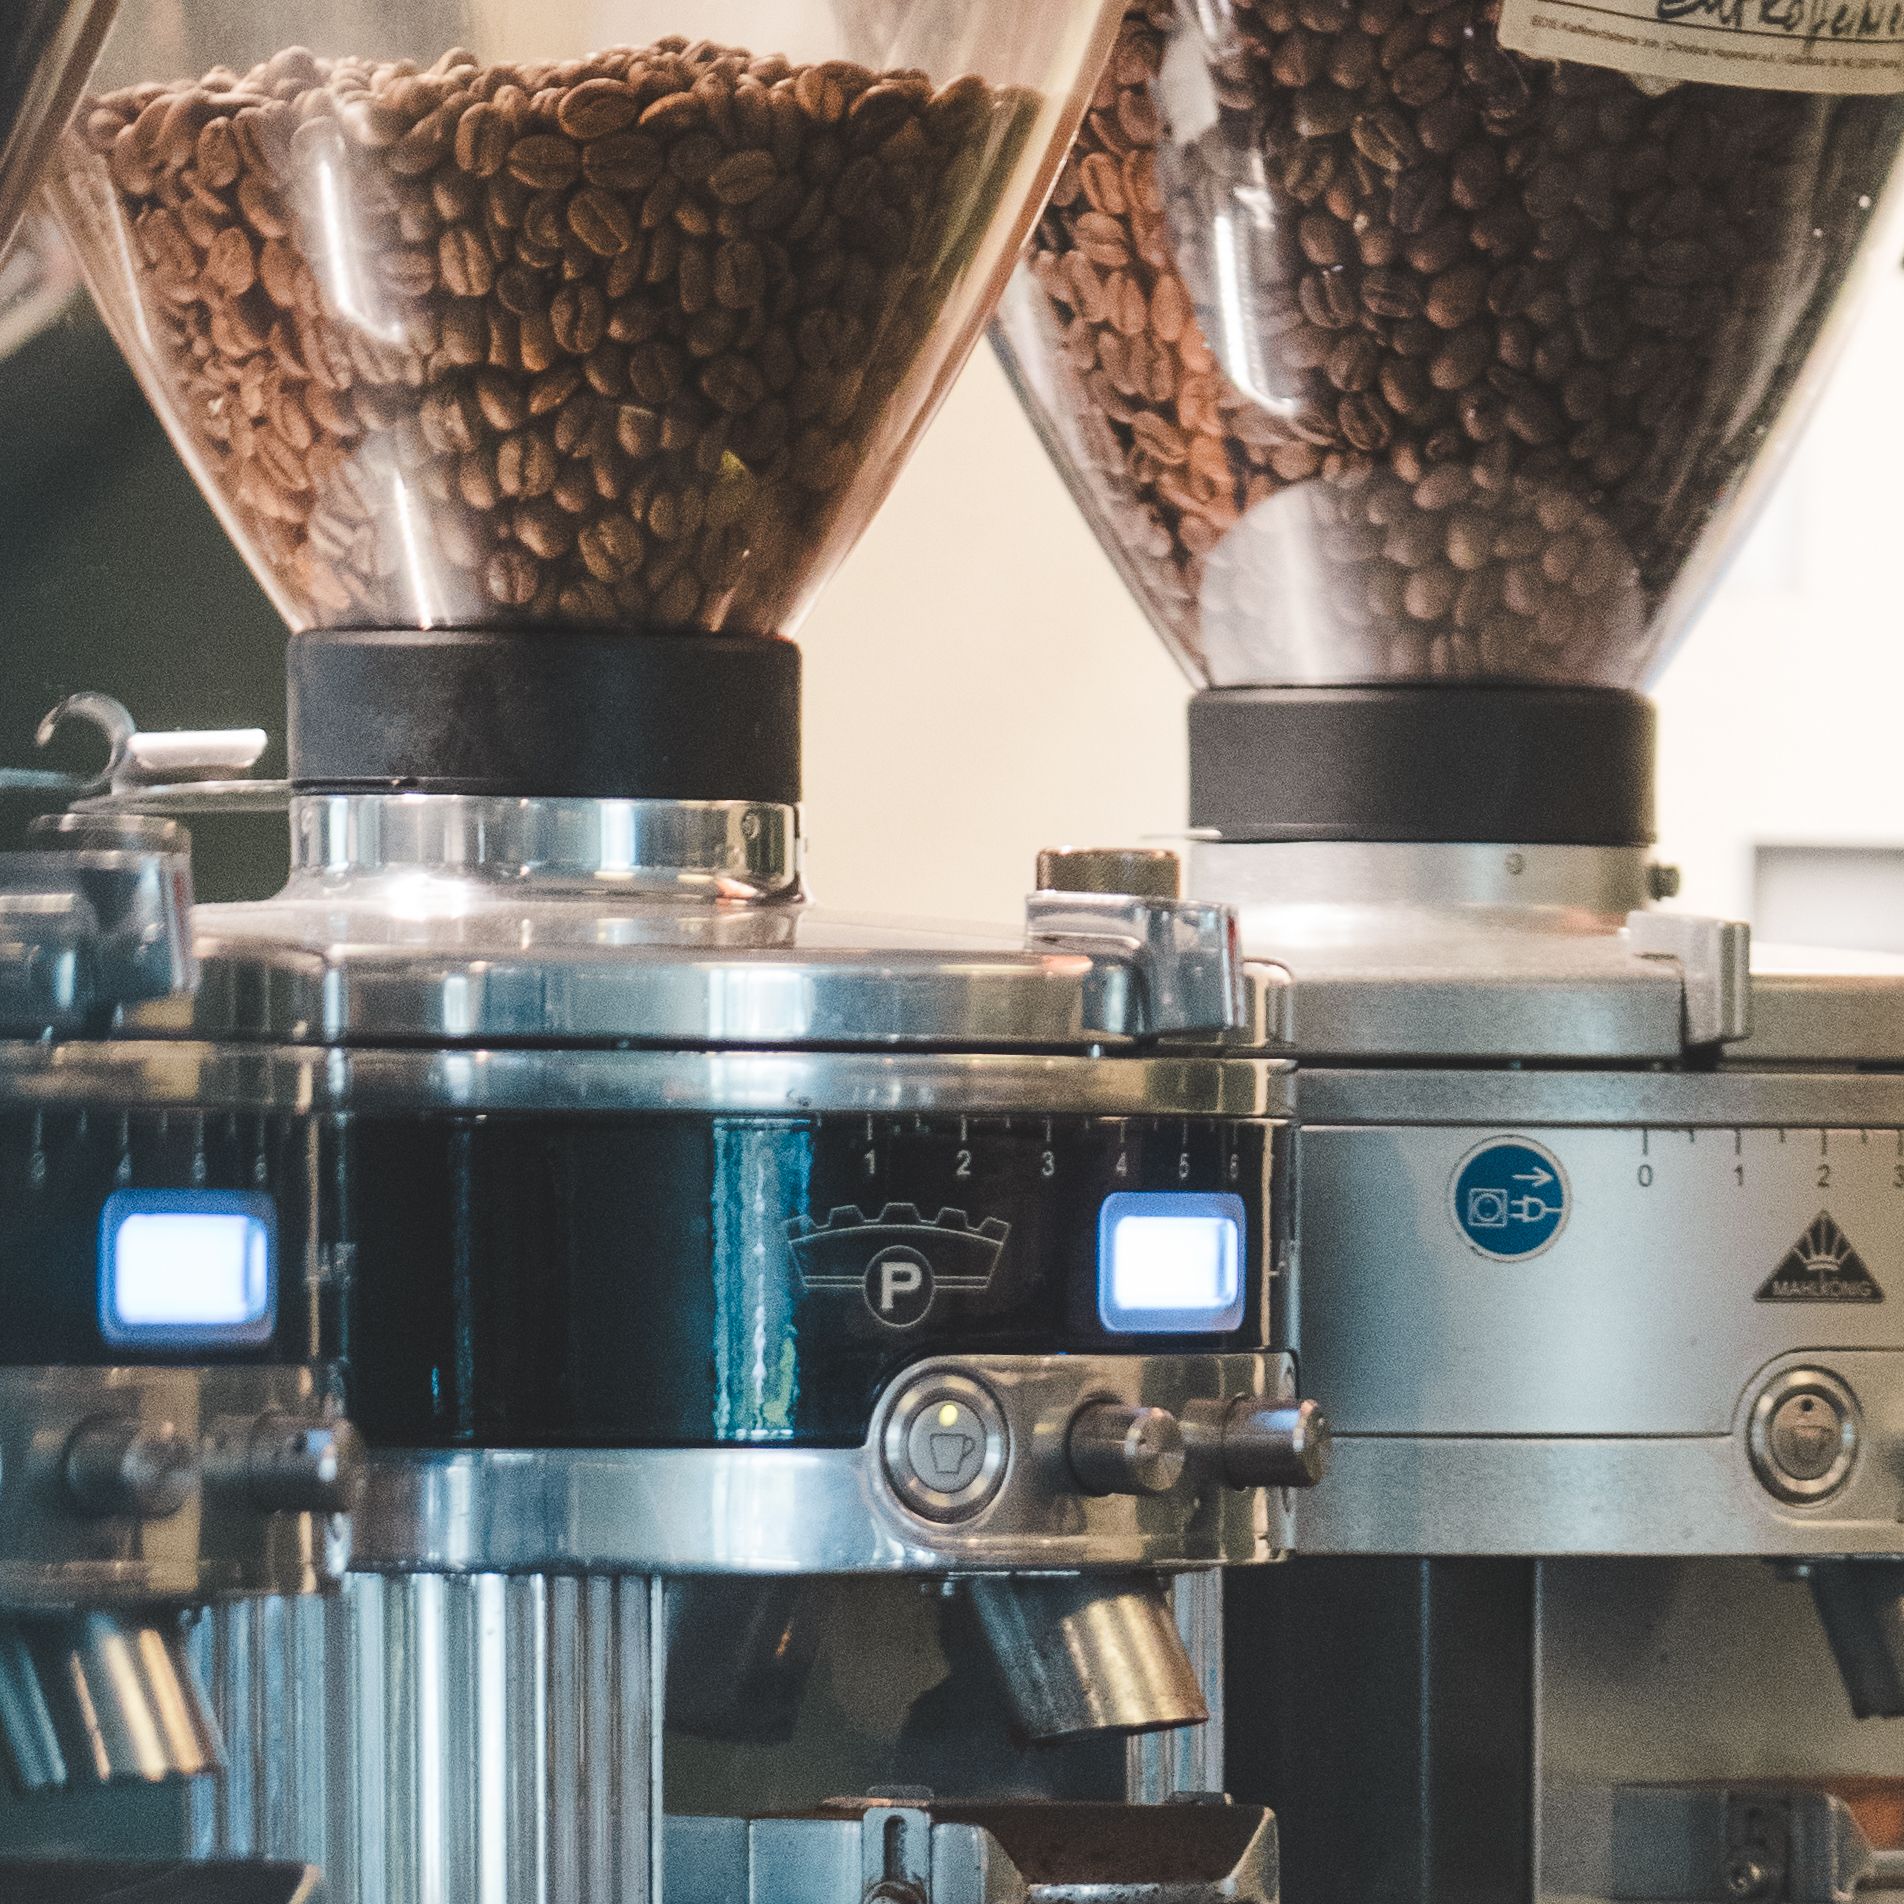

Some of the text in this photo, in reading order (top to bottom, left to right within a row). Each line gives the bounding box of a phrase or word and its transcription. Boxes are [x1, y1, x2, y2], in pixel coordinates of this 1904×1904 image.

[864, 1150, 876, 1175] 1
[956, 1149, 972, 1177] 2
[1042, 1150, 1055, 1177] 3
[1116, 1151, 1128, 1178] 4
[1637, 1164, 1654, 1188] 0
[1734, 1165, 1745, 1188] 1
[1817, 1164, 1832, 1188] 2
[880, 1261, 922, 1313] P
